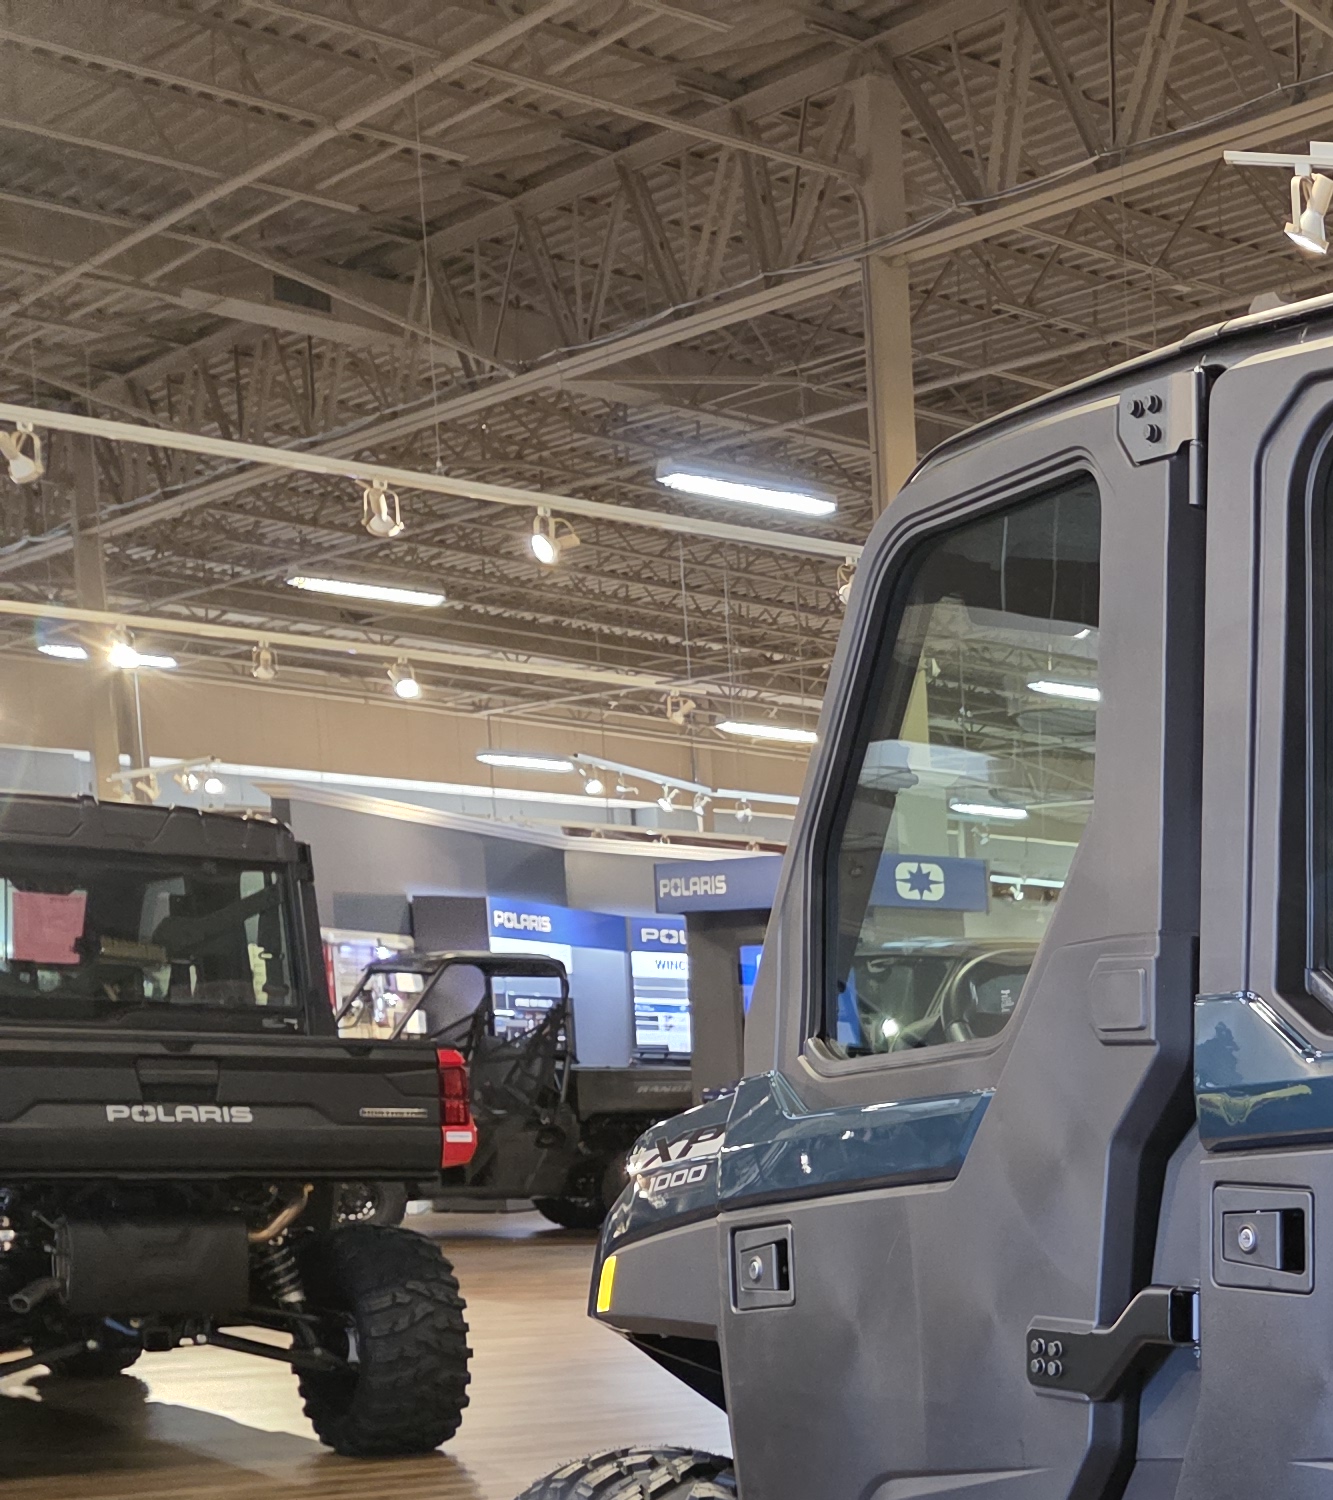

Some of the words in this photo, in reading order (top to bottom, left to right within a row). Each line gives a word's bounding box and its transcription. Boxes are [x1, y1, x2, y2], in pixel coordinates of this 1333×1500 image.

[660, 875, 727, 898] POLARIS
[493, 910, 552, 933] POLARIS
[106, 1105, 253, 1123] POLARIS
[641, 1121, 728, 1169] XP
[648, 1164, 708, 1194] 1000
